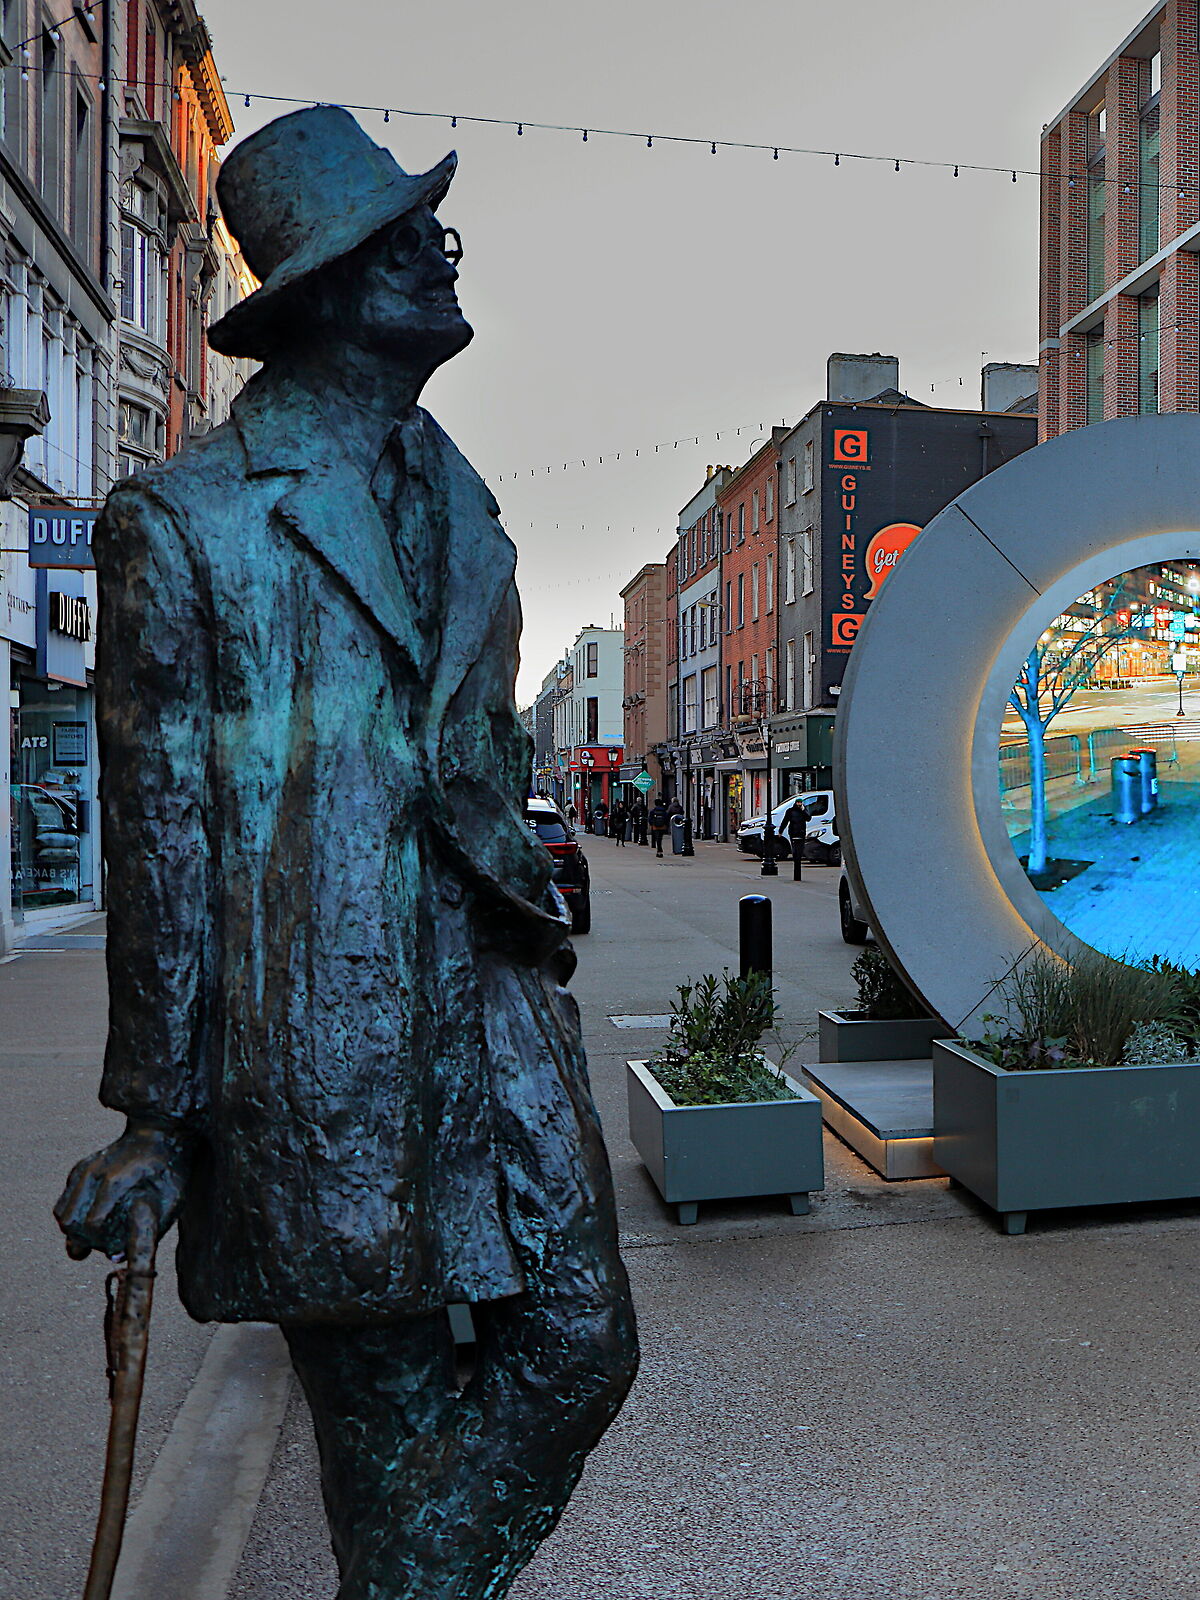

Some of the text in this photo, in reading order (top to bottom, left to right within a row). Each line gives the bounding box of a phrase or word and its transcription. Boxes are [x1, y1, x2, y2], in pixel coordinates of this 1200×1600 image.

[839, 434, 861, 458] G
[841, 474, 857, 610] GUINEYS
[874, 548, 899, 574] Get
